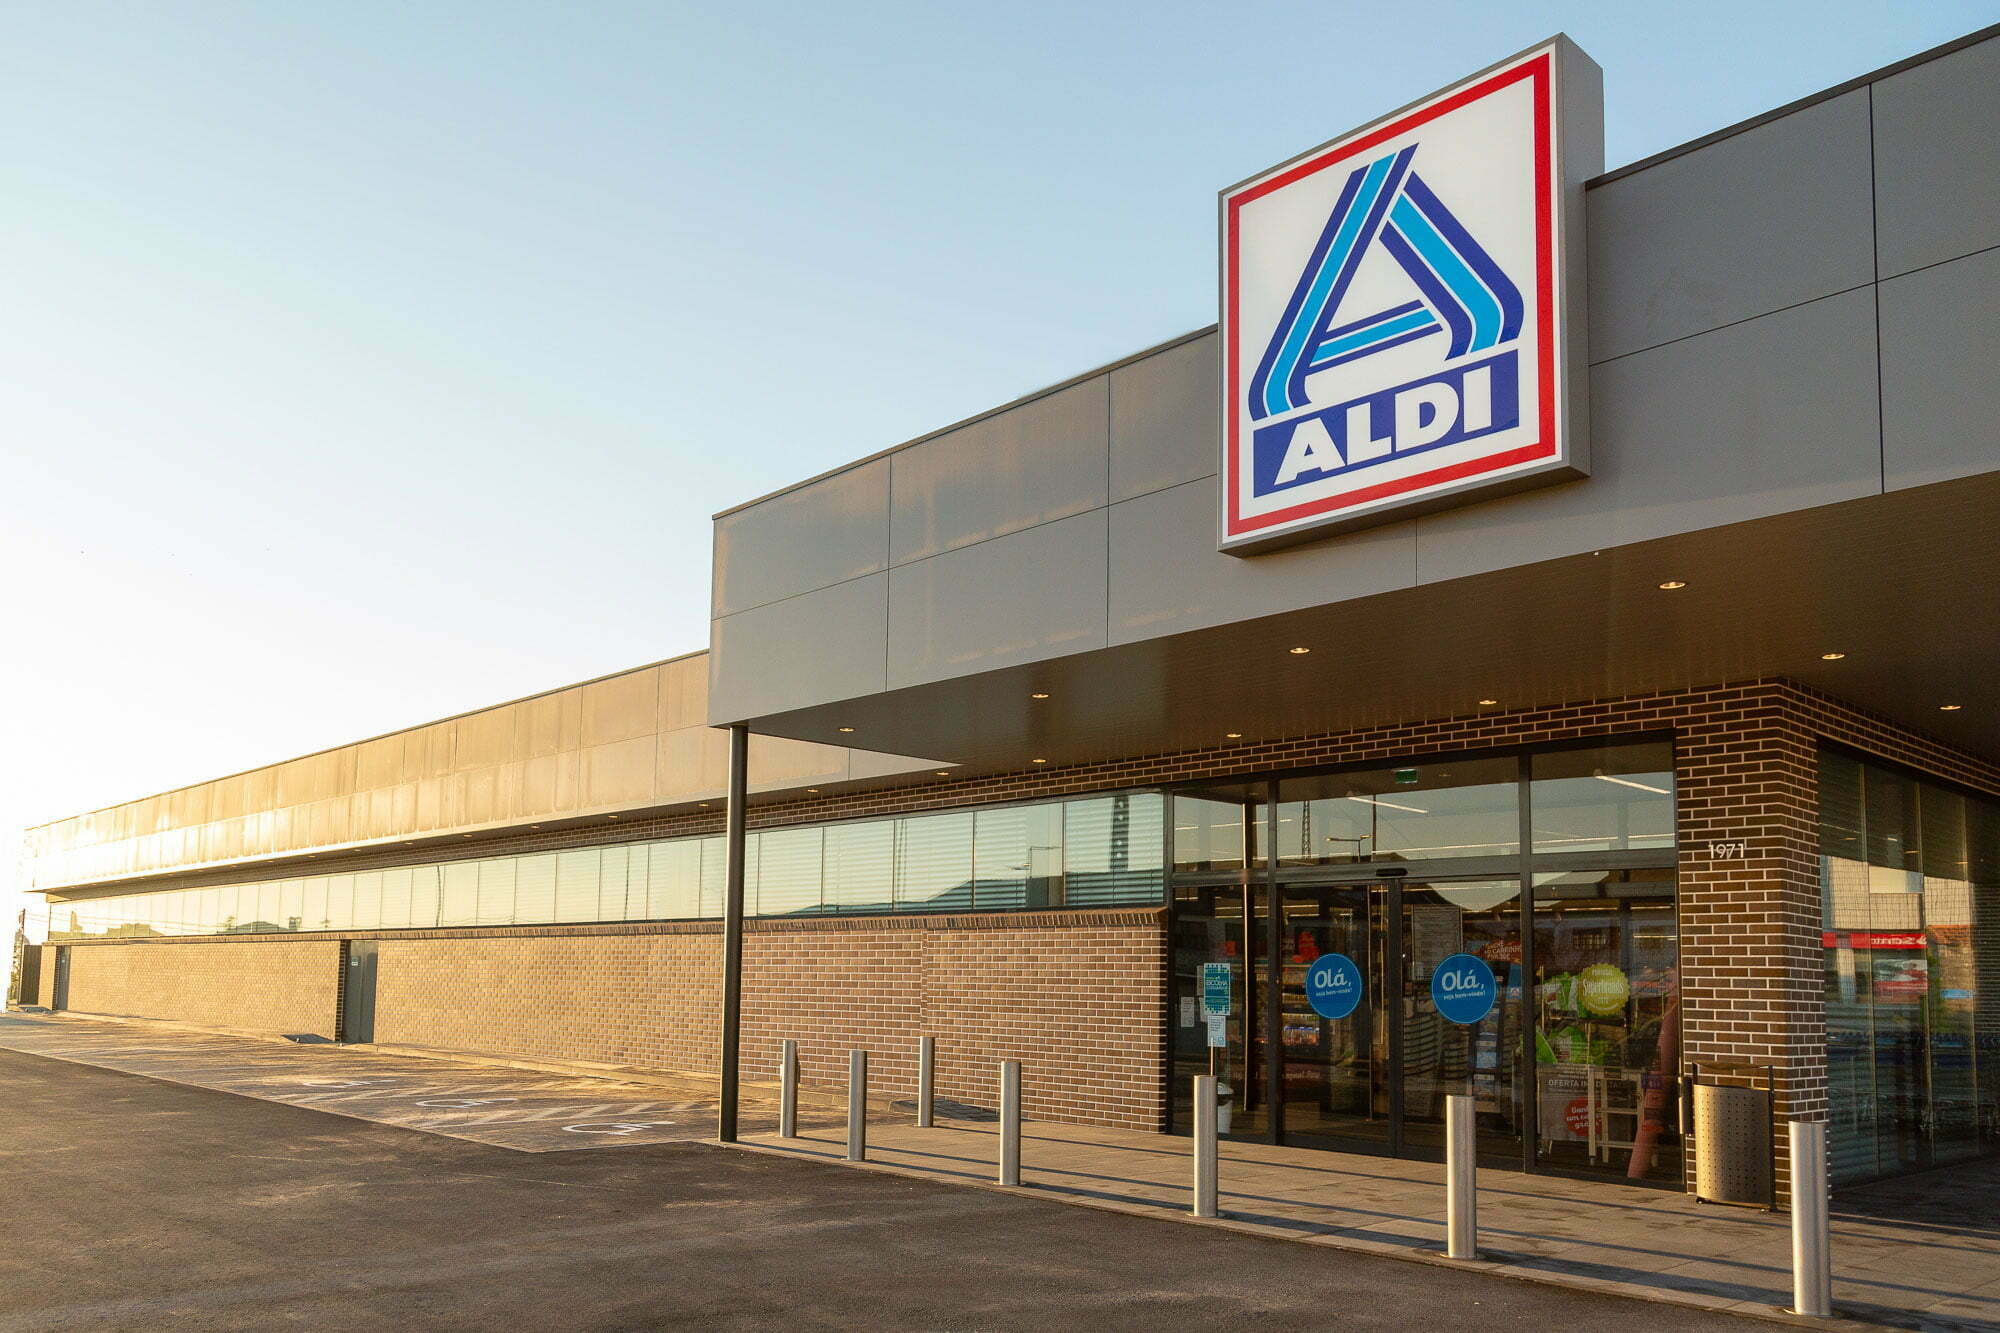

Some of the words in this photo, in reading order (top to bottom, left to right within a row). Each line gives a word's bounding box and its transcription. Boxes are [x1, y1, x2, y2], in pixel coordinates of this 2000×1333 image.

[1273, 365, 1492, 487] ALDI
[1708, 843, 1744, 859] 1971
[1314, 967, 1352, 989] Olá,
[1441, 968, 1485, 991] Olá,
[1548, 1079, 1580, 1088] OFERTA
